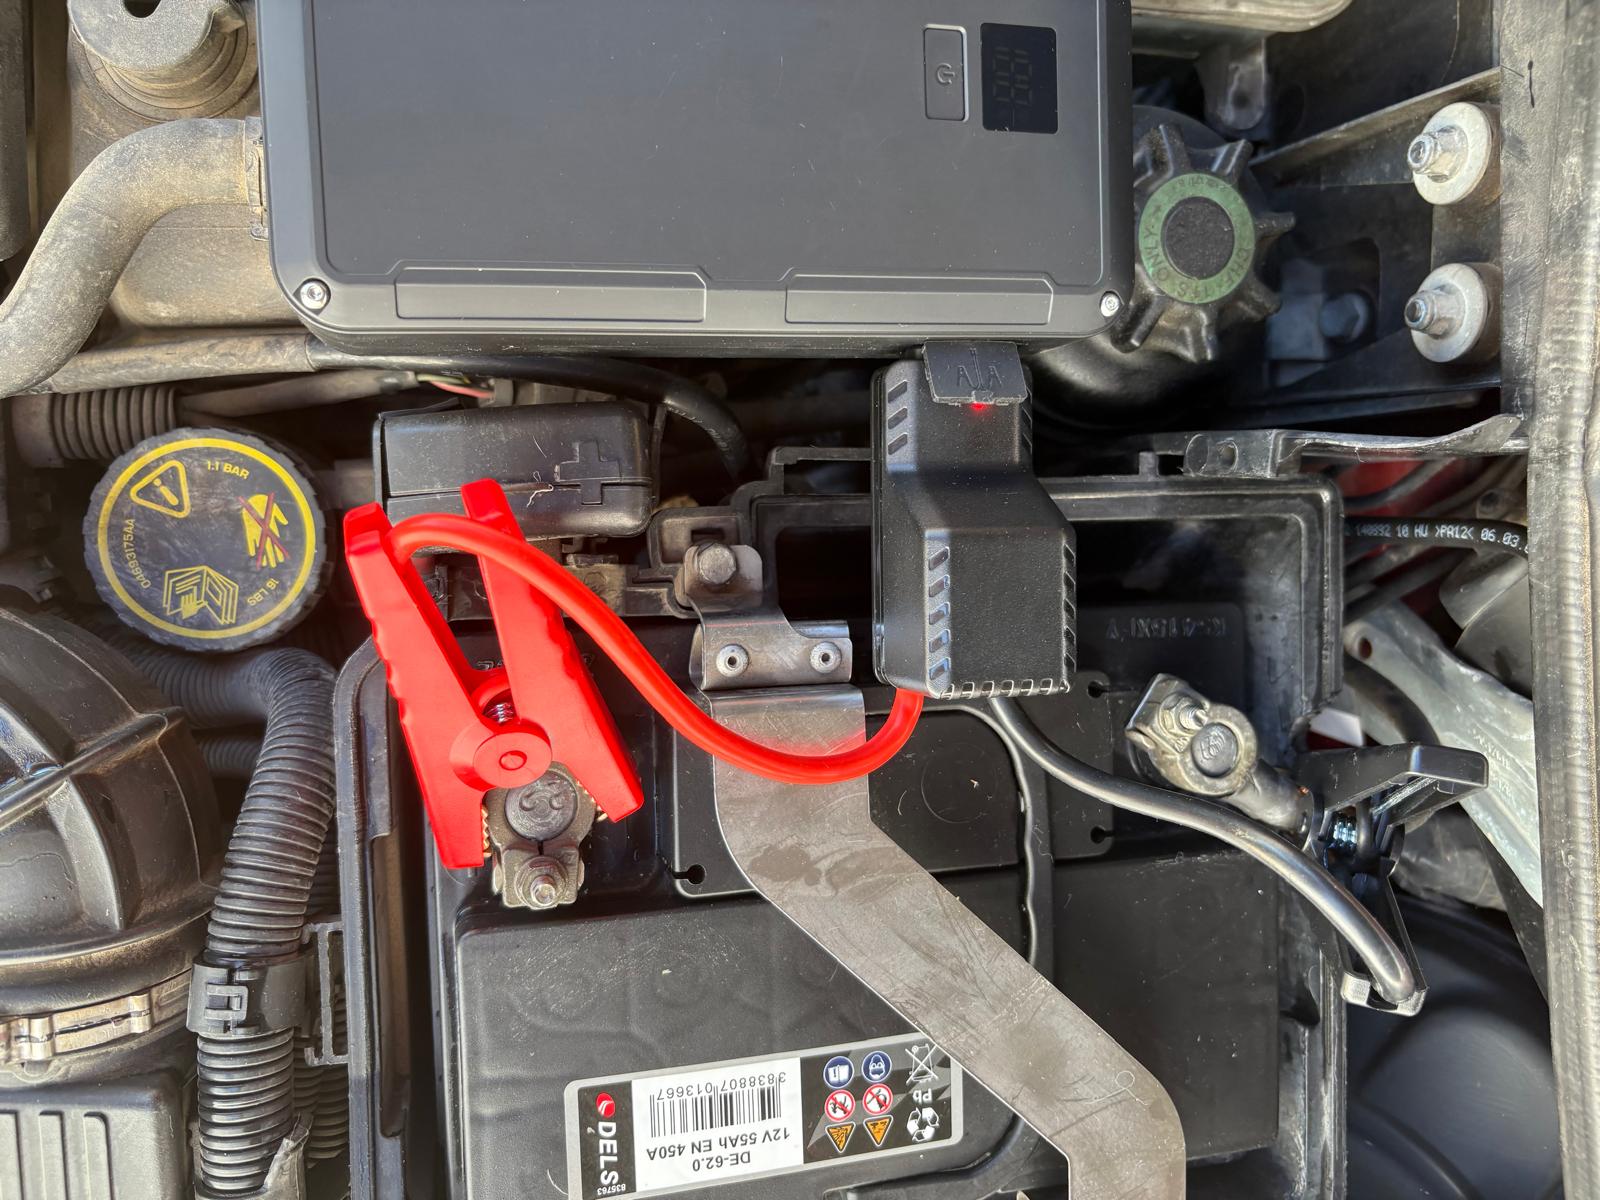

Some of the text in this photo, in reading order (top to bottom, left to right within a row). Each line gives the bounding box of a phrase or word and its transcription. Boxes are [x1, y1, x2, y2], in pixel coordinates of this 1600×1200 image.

[206, 460, 250, 480] 1.1 BAR
[247, 577, 280, 606] 16 LBS
[912, 1088, 933, 1104] Pb
[598, 1121, 620, 1186] DELS
[646, 1127, 790, 1162] 12V 55Ah EN 450A
[692, 1151, 752, 1173] DE-62.0
[596, 1184, 627, 1198] 835763
